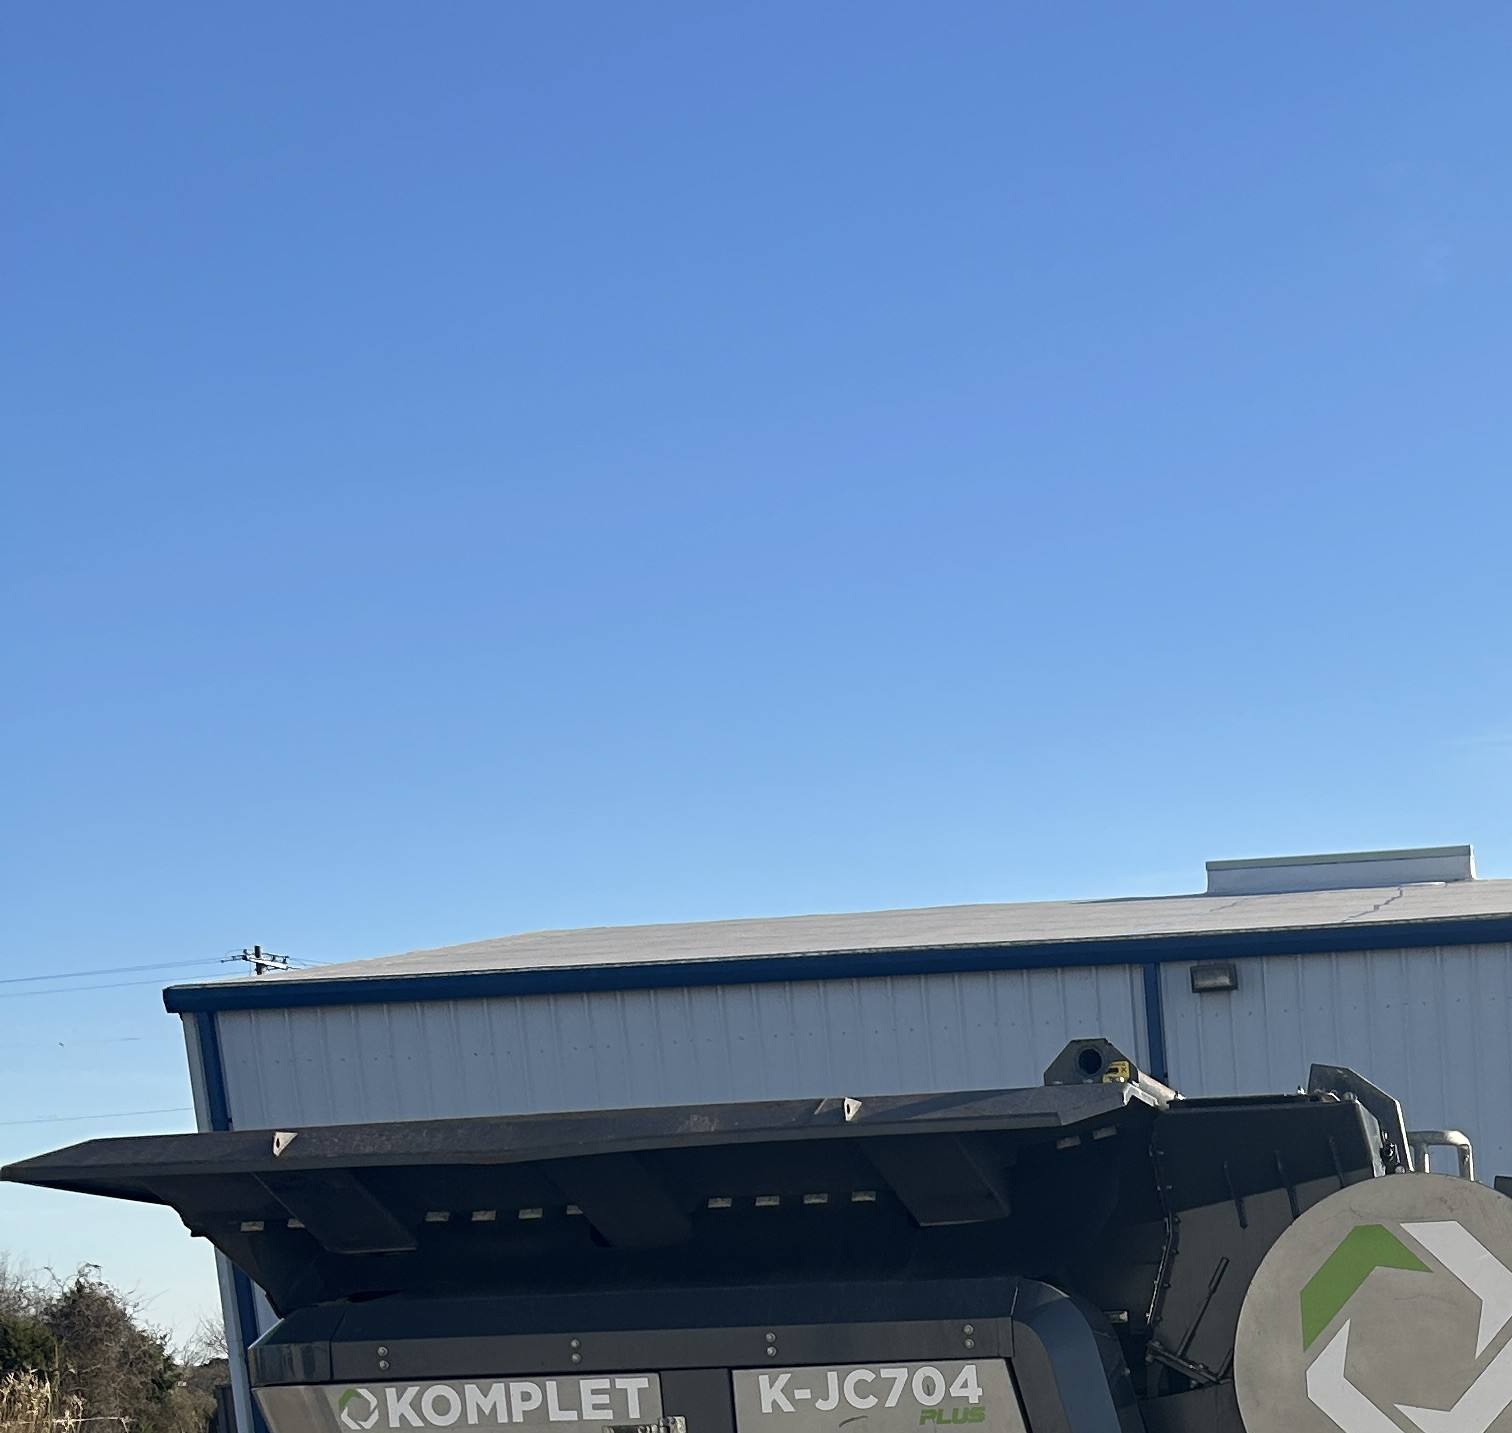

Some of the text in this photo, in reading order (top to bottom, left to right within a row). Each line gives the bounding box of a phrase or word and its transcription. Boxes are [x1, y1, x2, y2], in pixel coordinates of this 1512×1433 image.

[385, 1377, 649, 1428] KOMPLET
[758, 1364, 983, 1413] K-JC704
[918, 1406, 986, 1425] PLUS
